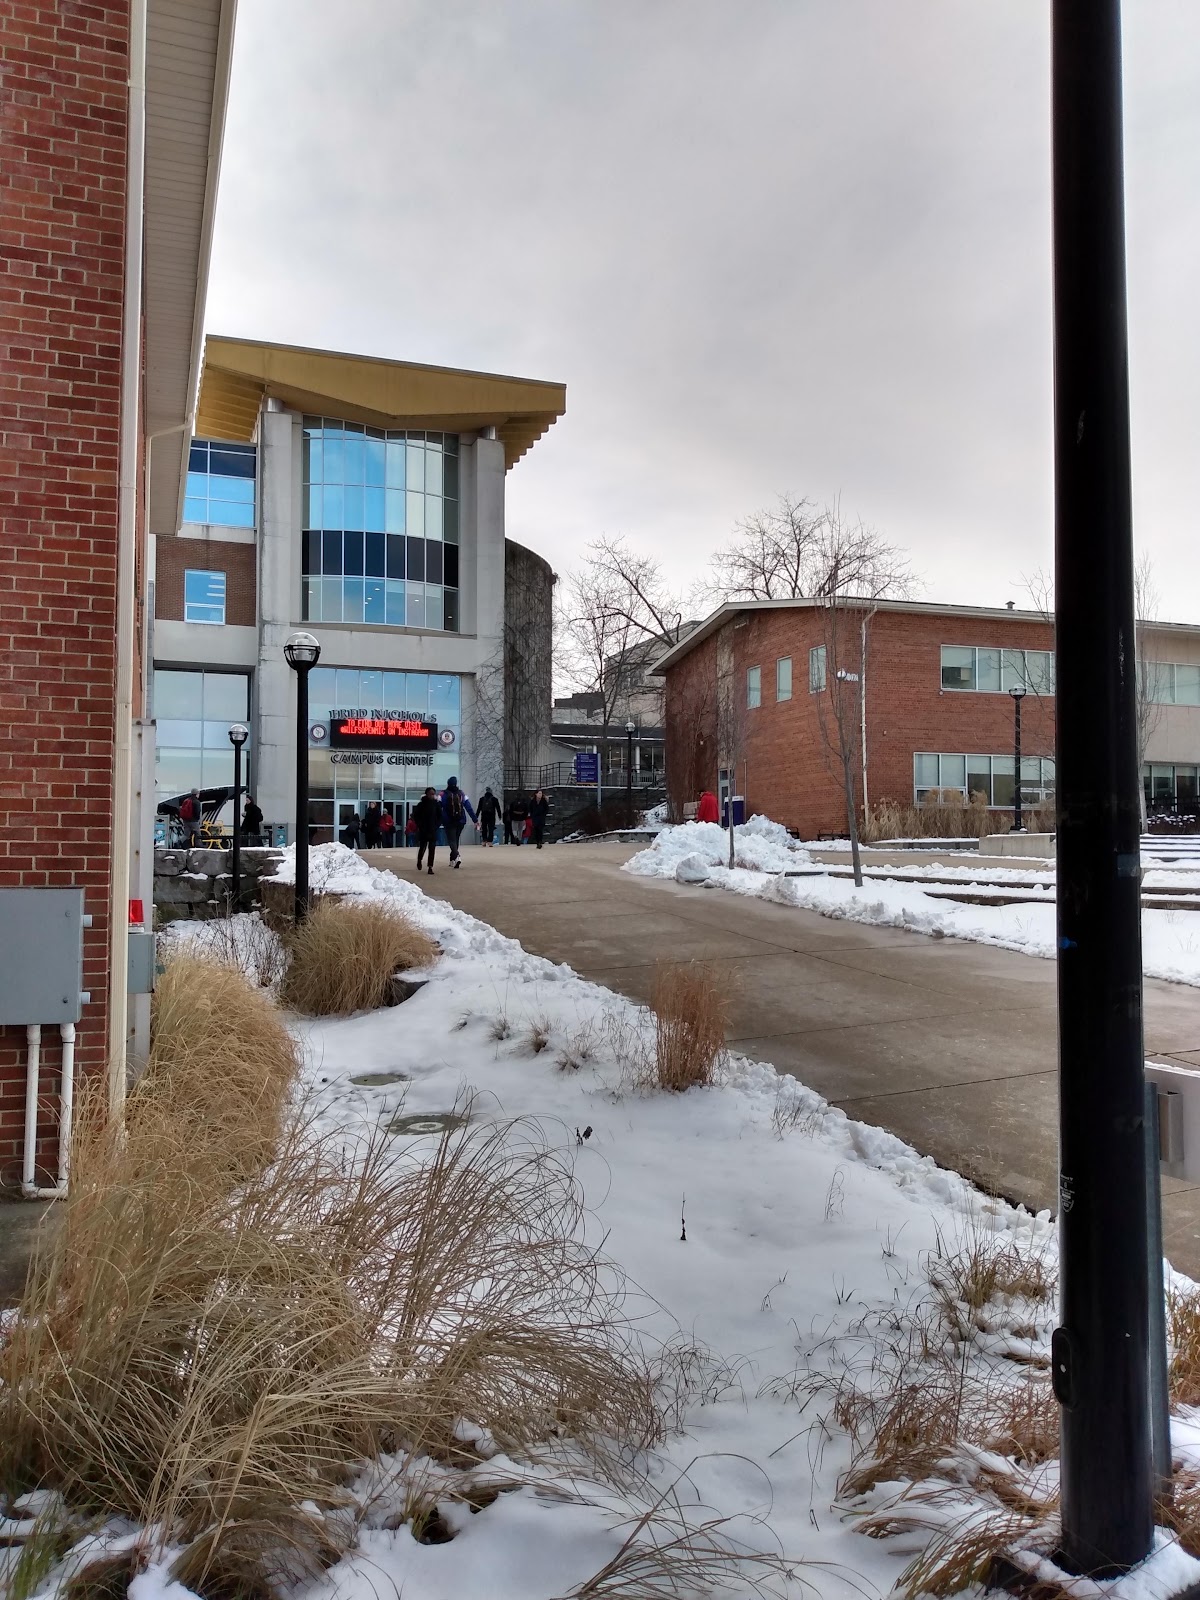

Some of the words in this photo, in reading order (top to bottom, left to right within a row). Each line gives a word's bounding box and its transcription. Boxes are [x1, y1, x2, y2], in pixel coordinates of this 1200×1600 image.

[329, 709, 368, 719] FRED
[371, 709, 437, 722] NICHOLS
[347, 719, 355, 727] TO
[358, 719, 373, 728] FIND
[374, 720, 385, 728] OUT
[388, 721, 402, 729] MORE
[404, 721, 422, 730] VISIT
[387, 728, 396, 736] ON
[398, 728, 429, 737] INSTAGRAM
[330, 752, 384, 764] CAMPUS
[387, 755, 434, 766] CENTRE
